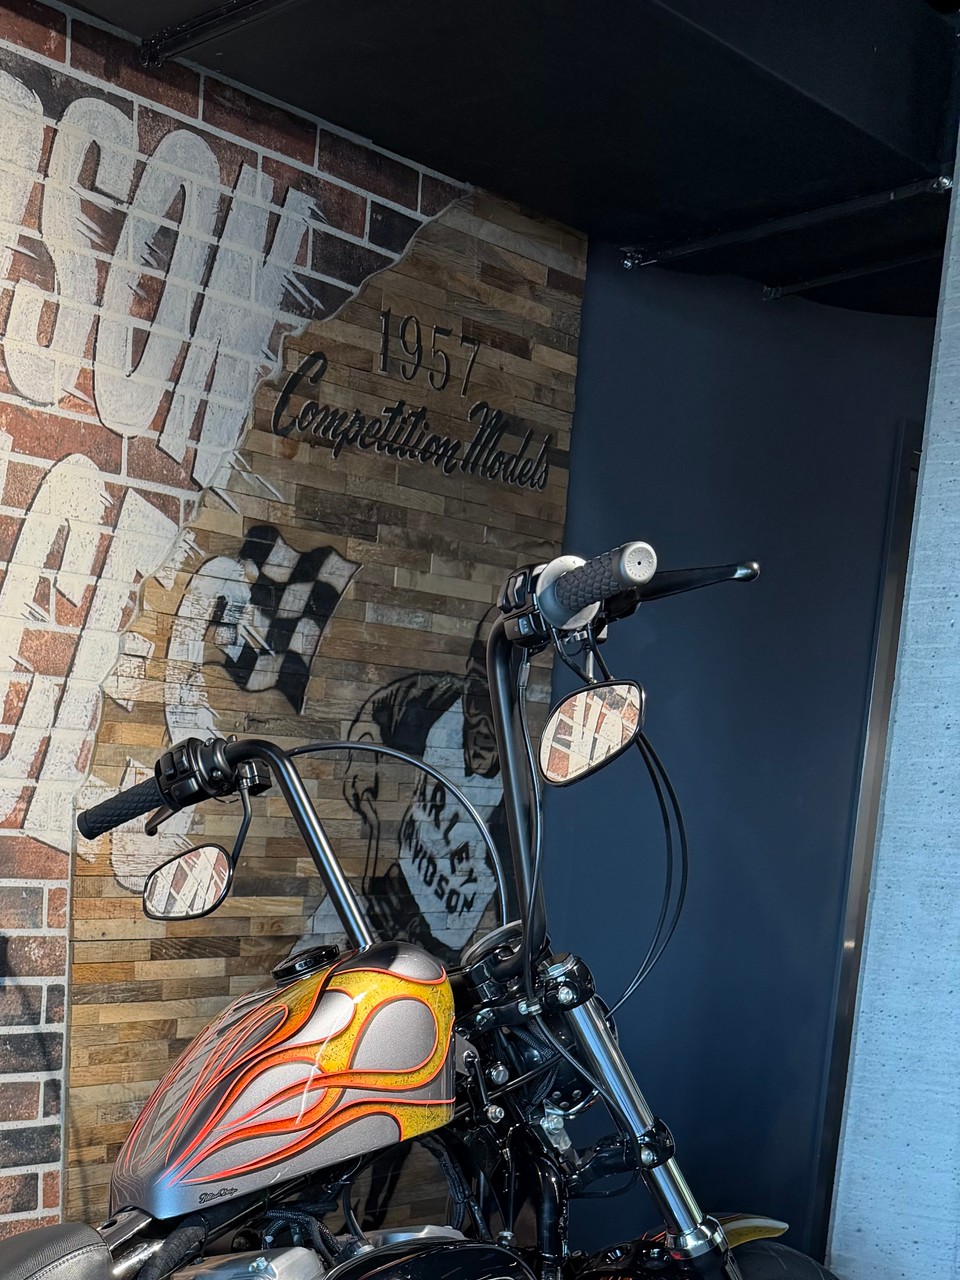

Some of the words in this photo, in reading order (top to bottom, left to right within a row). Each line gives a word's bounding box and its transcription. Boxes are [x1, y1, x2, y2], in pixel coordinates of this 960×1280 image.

[378, 307, 480, 399] 1957
[271, 351, 462, 477] Competition
[460, 402, 553, 491] Models
